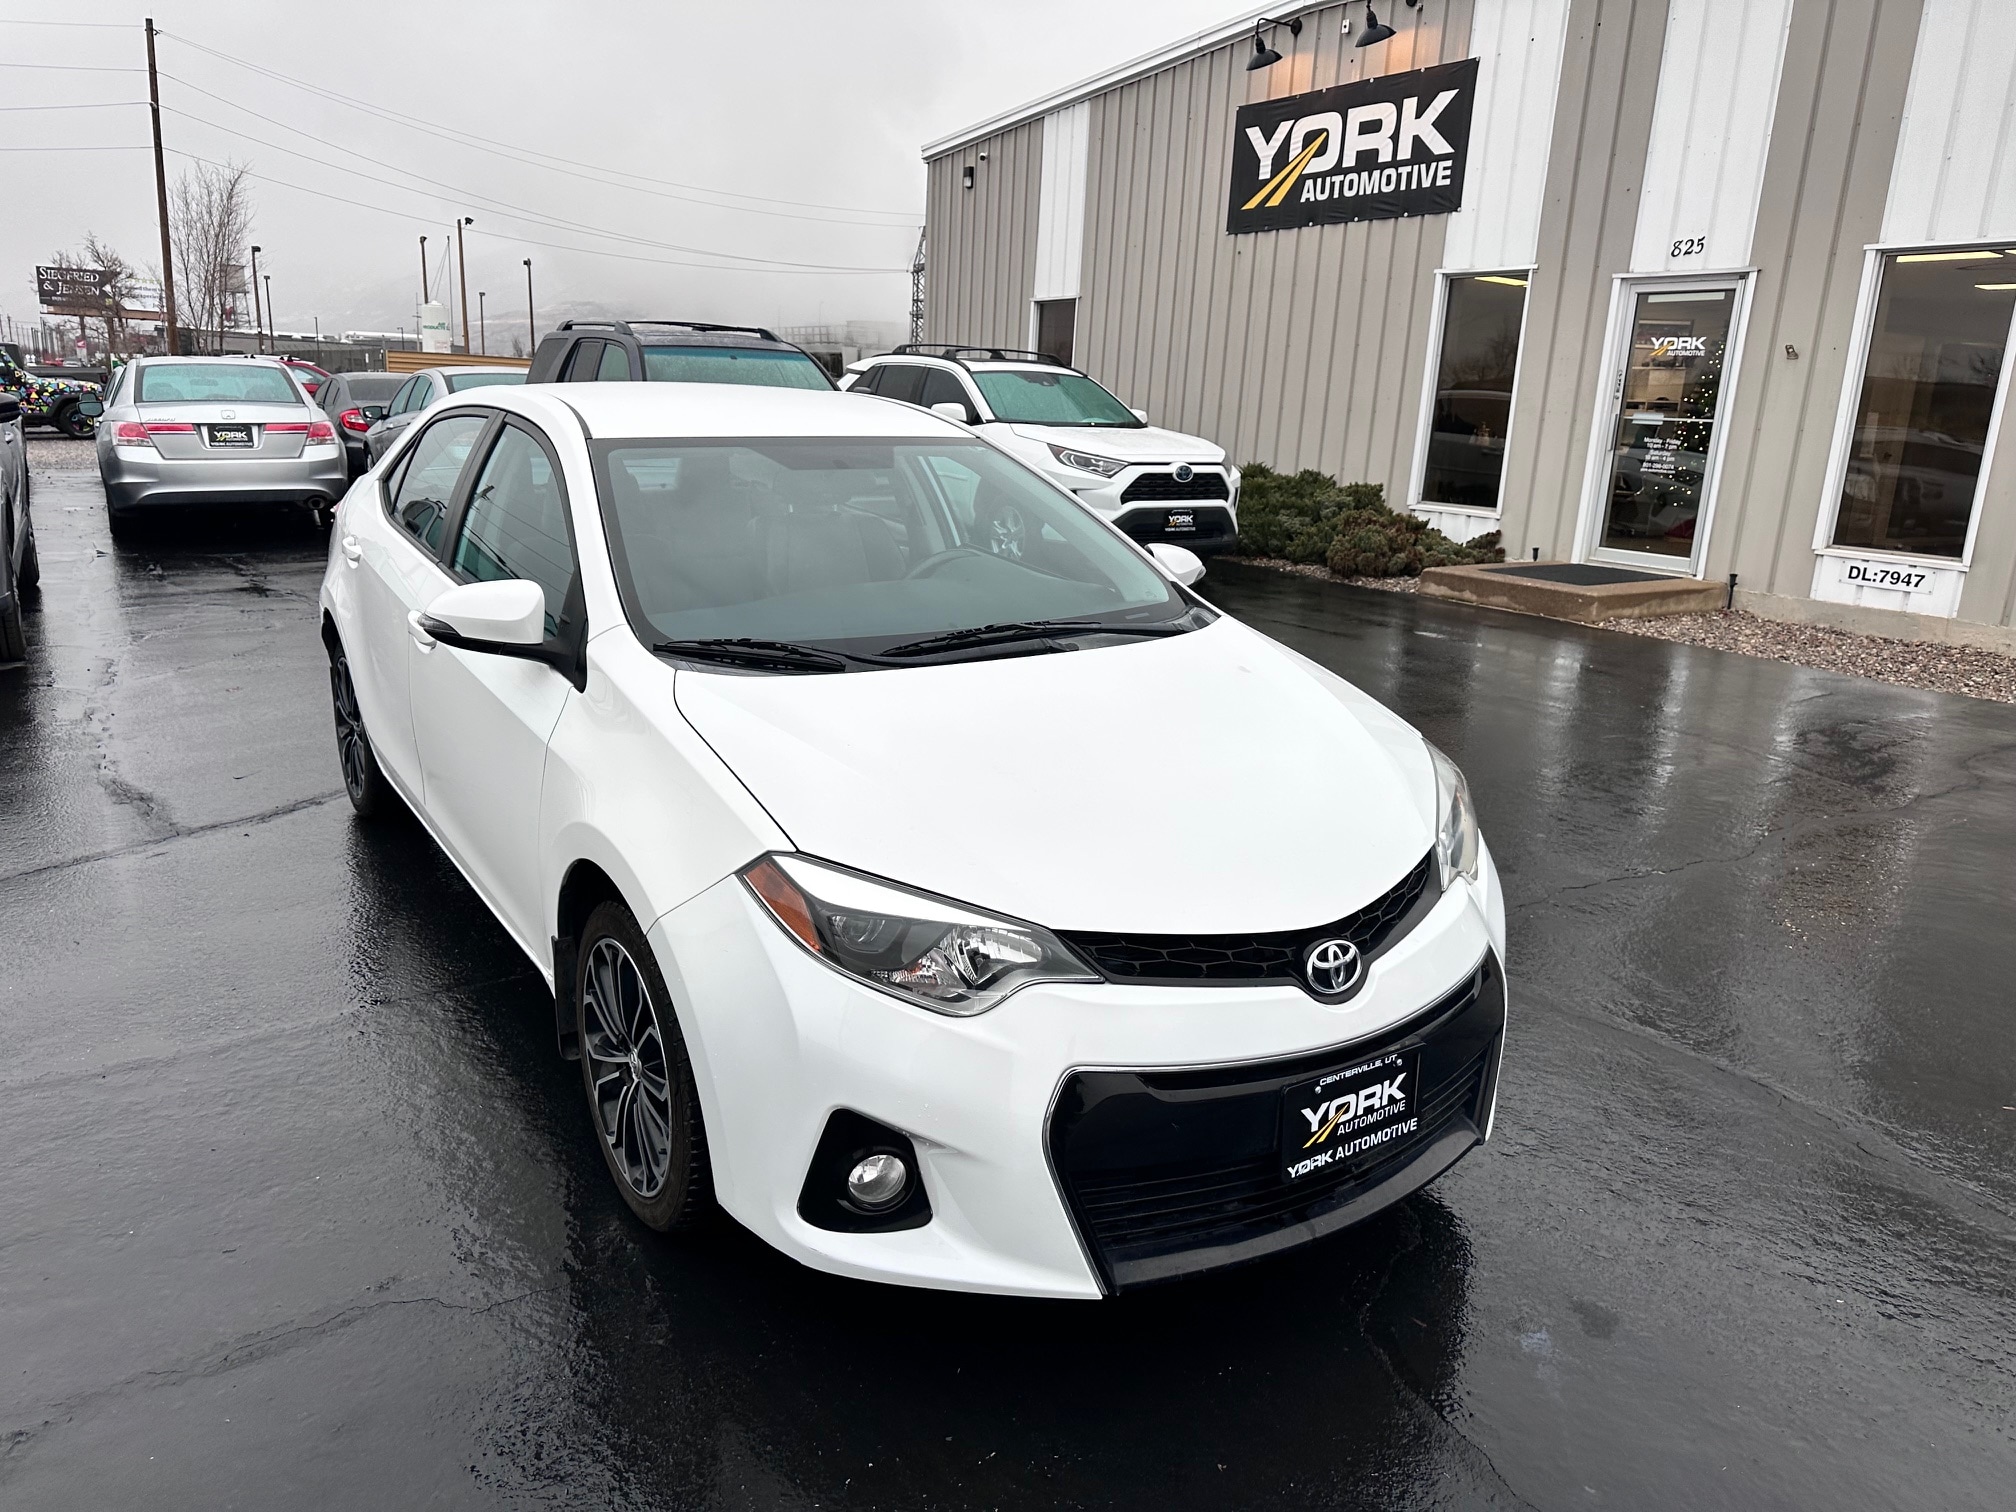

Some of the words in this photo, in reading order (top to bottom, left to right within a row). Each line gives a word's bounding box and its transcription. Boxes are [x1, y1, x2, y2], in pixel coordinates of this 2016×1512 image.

[1245, 89, 1459, 180] YORK
[1300, 160, 1453, 202] AUTOMOTIVE
[1671, 236, 1705, 257] 825
[39, 267, 99, 283] SIEGFRIED
[43, 280, 54, 291] &
[56, 281, 100, 296] JENSEN
[1651, 336, 1707, 350] YORK
[213, 431, 248, 441] YORK
[1848, 565, 1926, 588] DL:7947
[1319, 1059, 1383, 1086] CENTERVILLE,
[1384, 1054, 1398, 1064] UT
[1300, 1072, 1407, 1133] YORK
[1337, 1099, 1406, 1136] AUTOMOTIVE
[1287, 1149, 1334, 1179] YORK
[1335, 1117, 1418, 1161] AUTOMOTIVE
